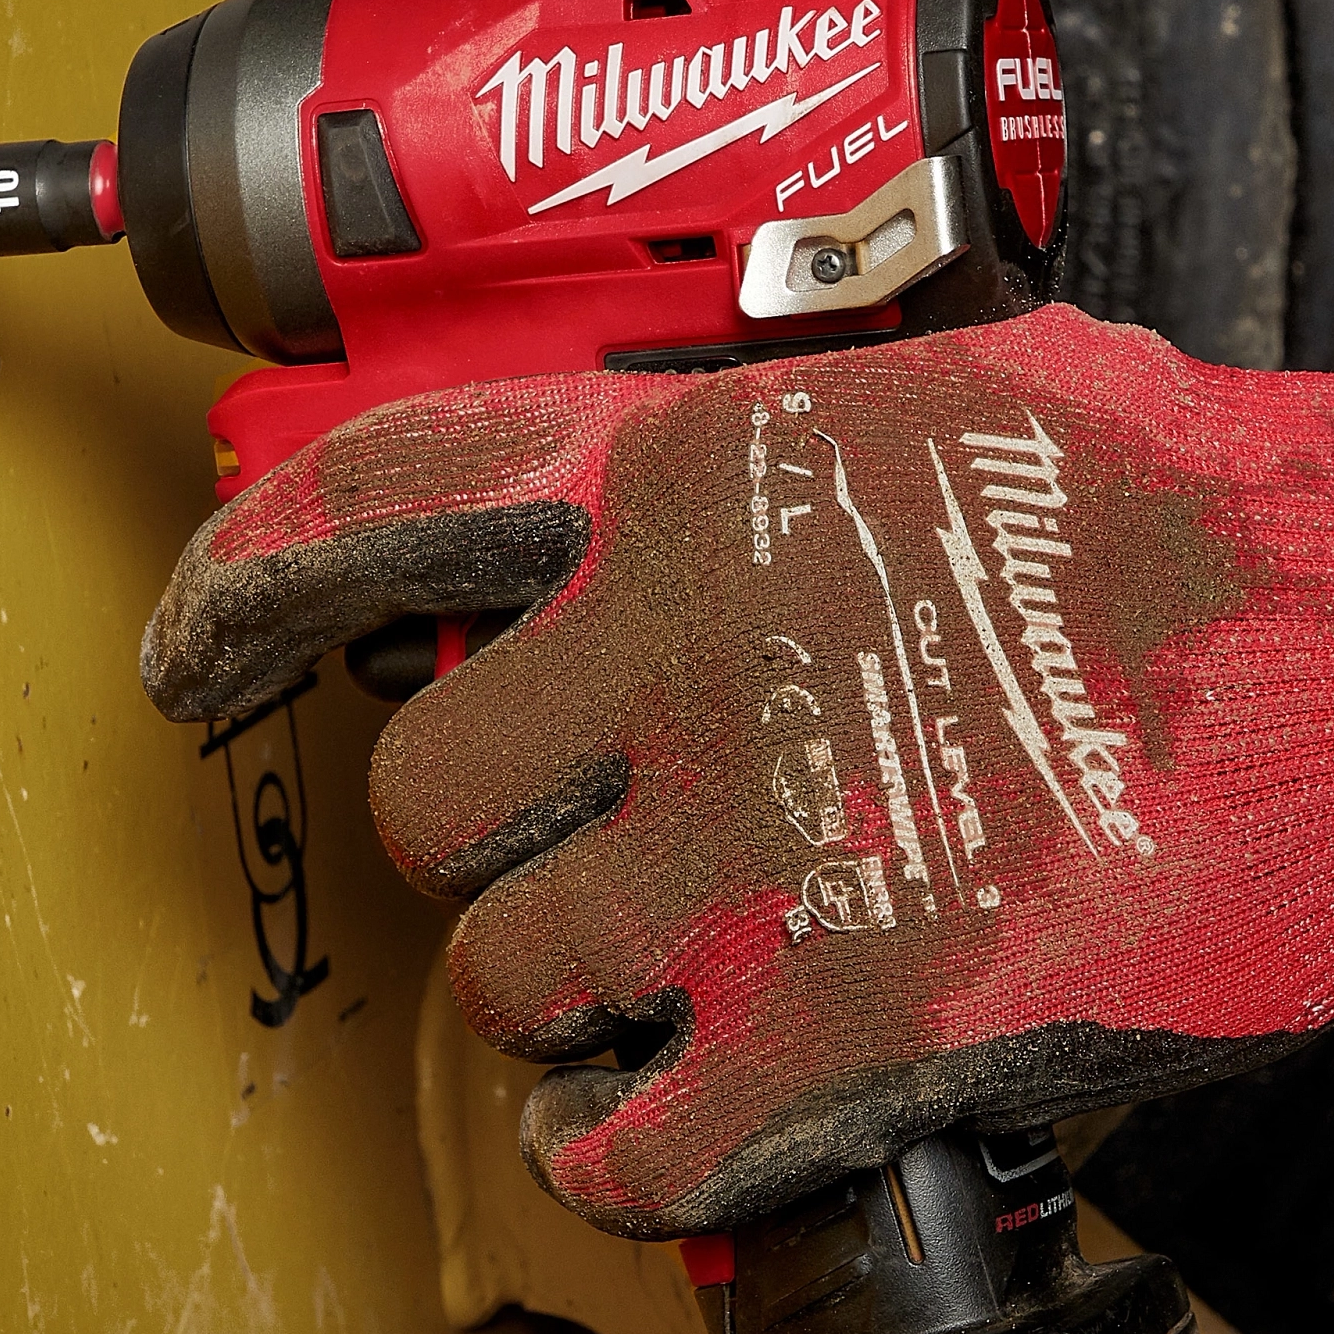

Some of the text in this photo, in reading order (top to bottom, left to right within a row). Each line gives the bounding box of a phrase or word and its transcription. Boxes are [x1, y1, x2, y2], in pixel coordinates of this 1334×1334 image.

[996, 57, 1063, 101] FUEL
[775, 116, 909, 212] FUEL
[782, 391, 812, 413] 9
[781, 504, 812, 534] L
[913, 599, 1002, 909] CUT LEVEL 3
